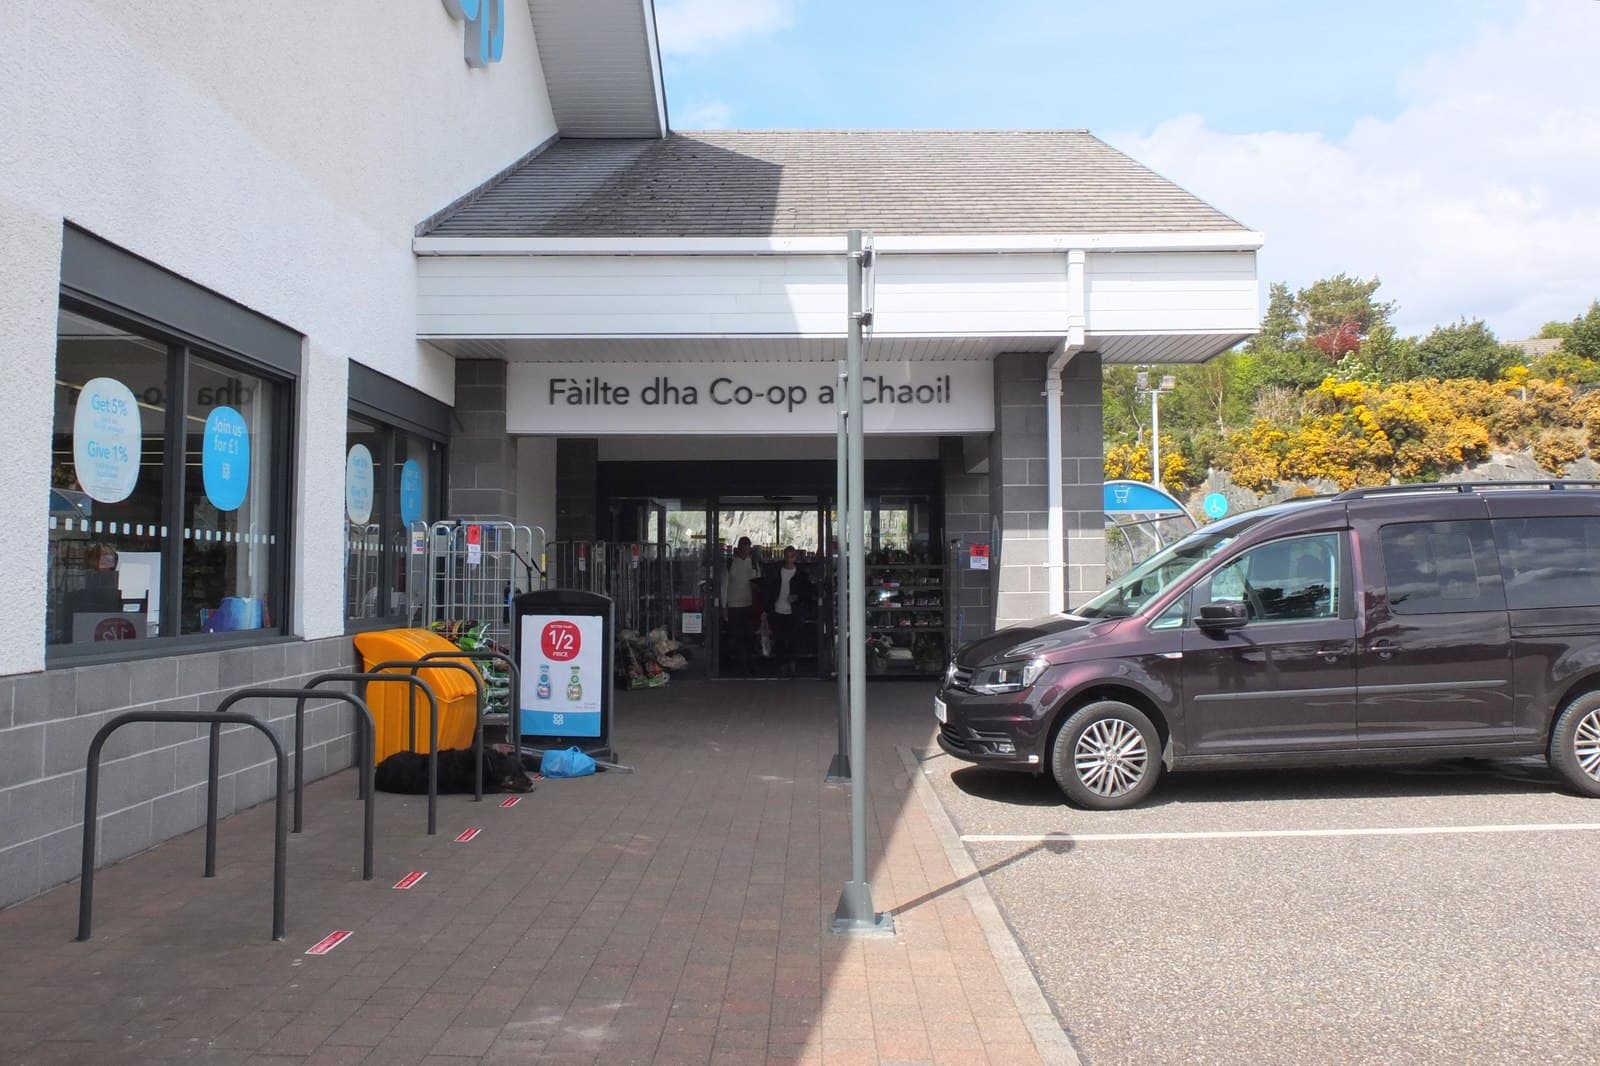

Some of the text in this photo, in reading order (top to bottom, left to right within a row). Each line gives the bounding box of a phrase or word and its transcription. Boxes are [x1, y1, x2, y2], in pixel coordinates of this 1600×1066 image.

[92, 394, 110, 412] Get
[111, 398, 128, 416] 5%
[549, 376, 631, 406] Fàilte
[641, 376, 698, 406] dha
[709, 377, 807, 413] Co-op
[212, 416, 241, 437] Join us
[87, 441, 128, 463] Give 1%
[214, 434, 226, 452] for
[549, 629, 573, 650] 1/2
